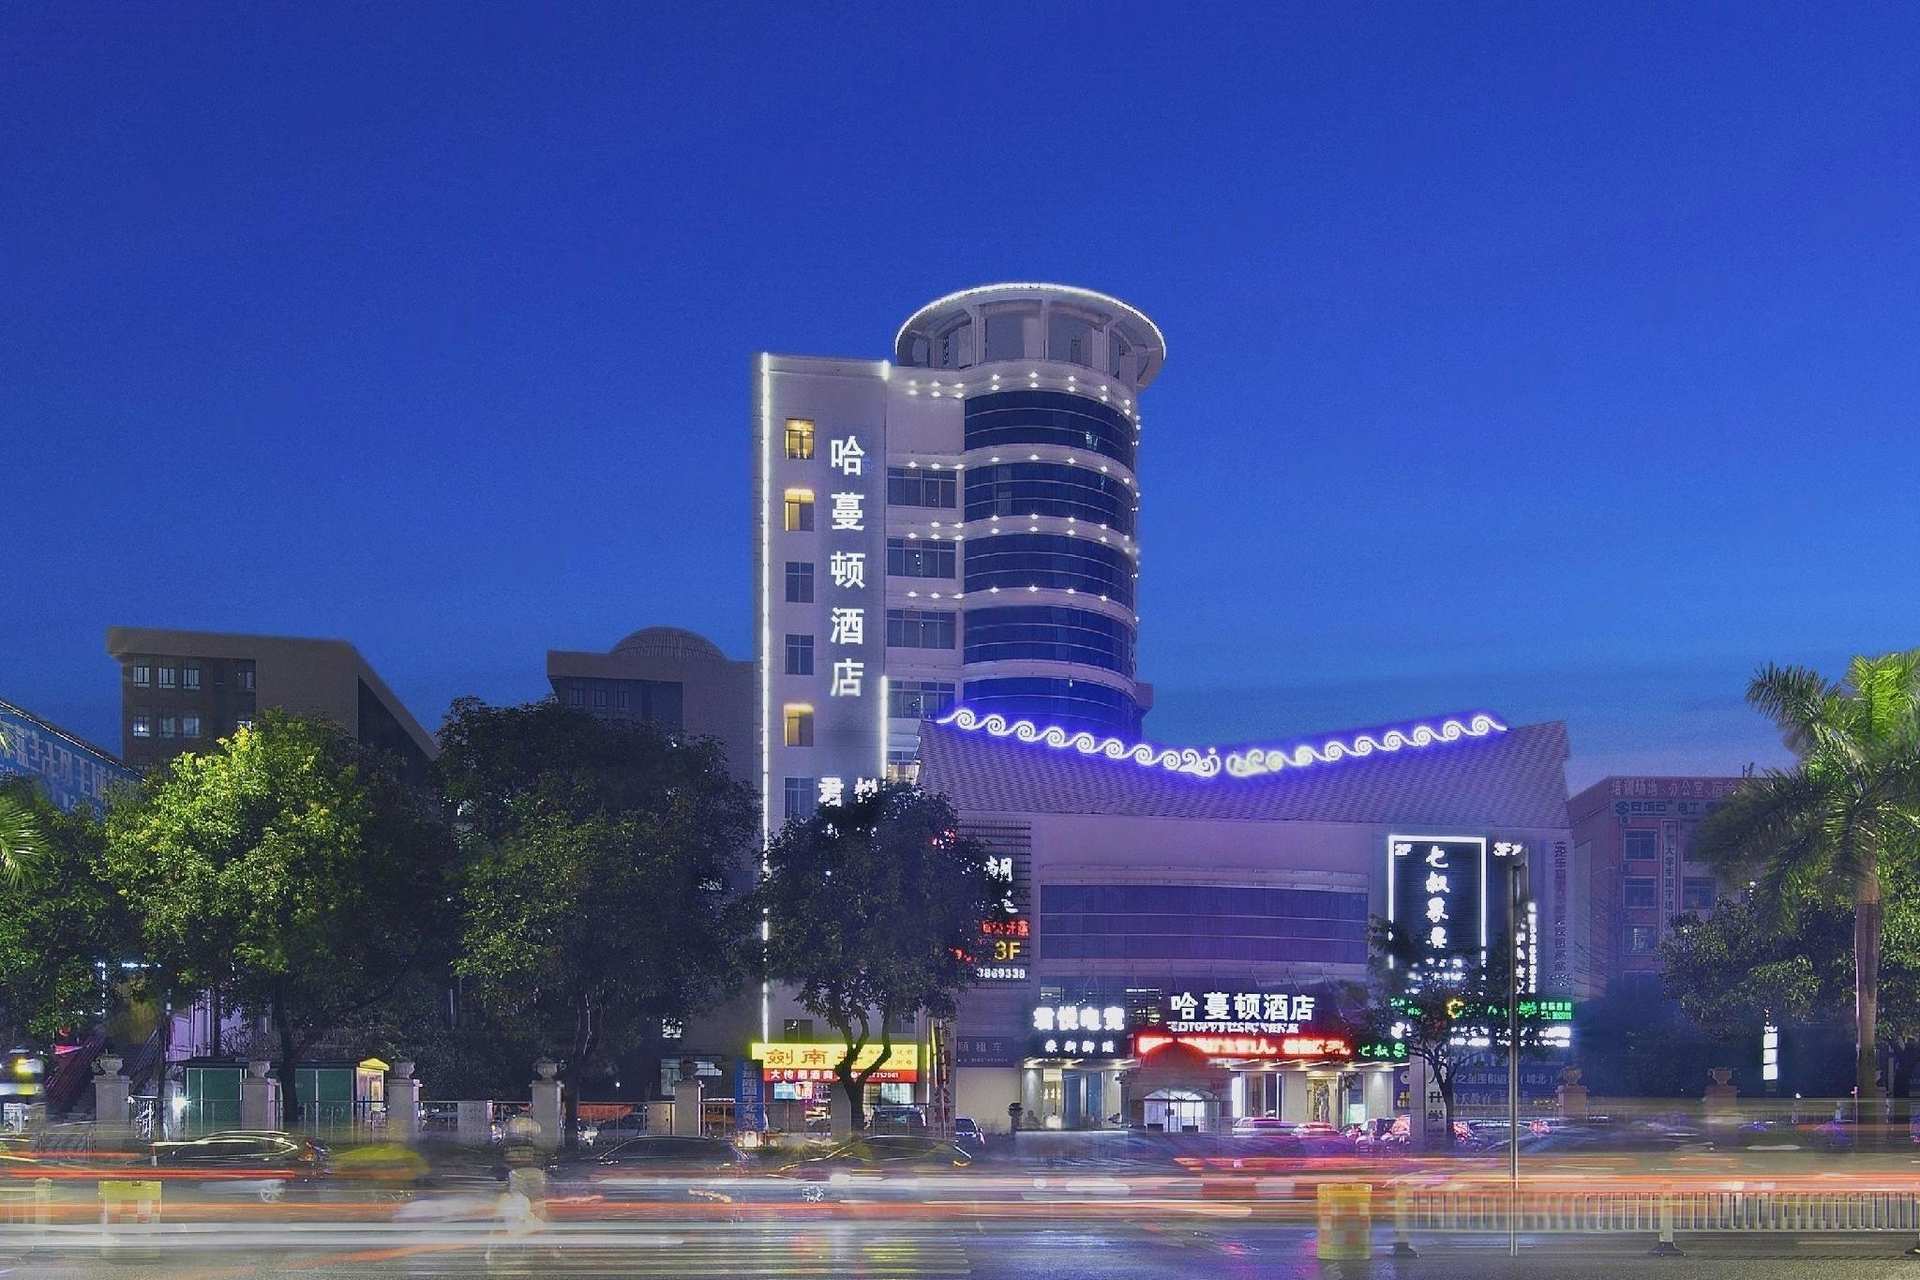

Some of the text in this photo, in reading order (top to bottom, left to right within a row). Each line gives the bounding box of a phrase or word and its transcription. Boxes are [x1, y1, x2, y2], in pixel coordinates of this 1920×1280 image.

[829, 435, 866, 697] 哈蔓顿酒店
[994, 940, 1021, 960] 3F
[1170, 992, 1316, 1022] 哈蔓顿酒店
